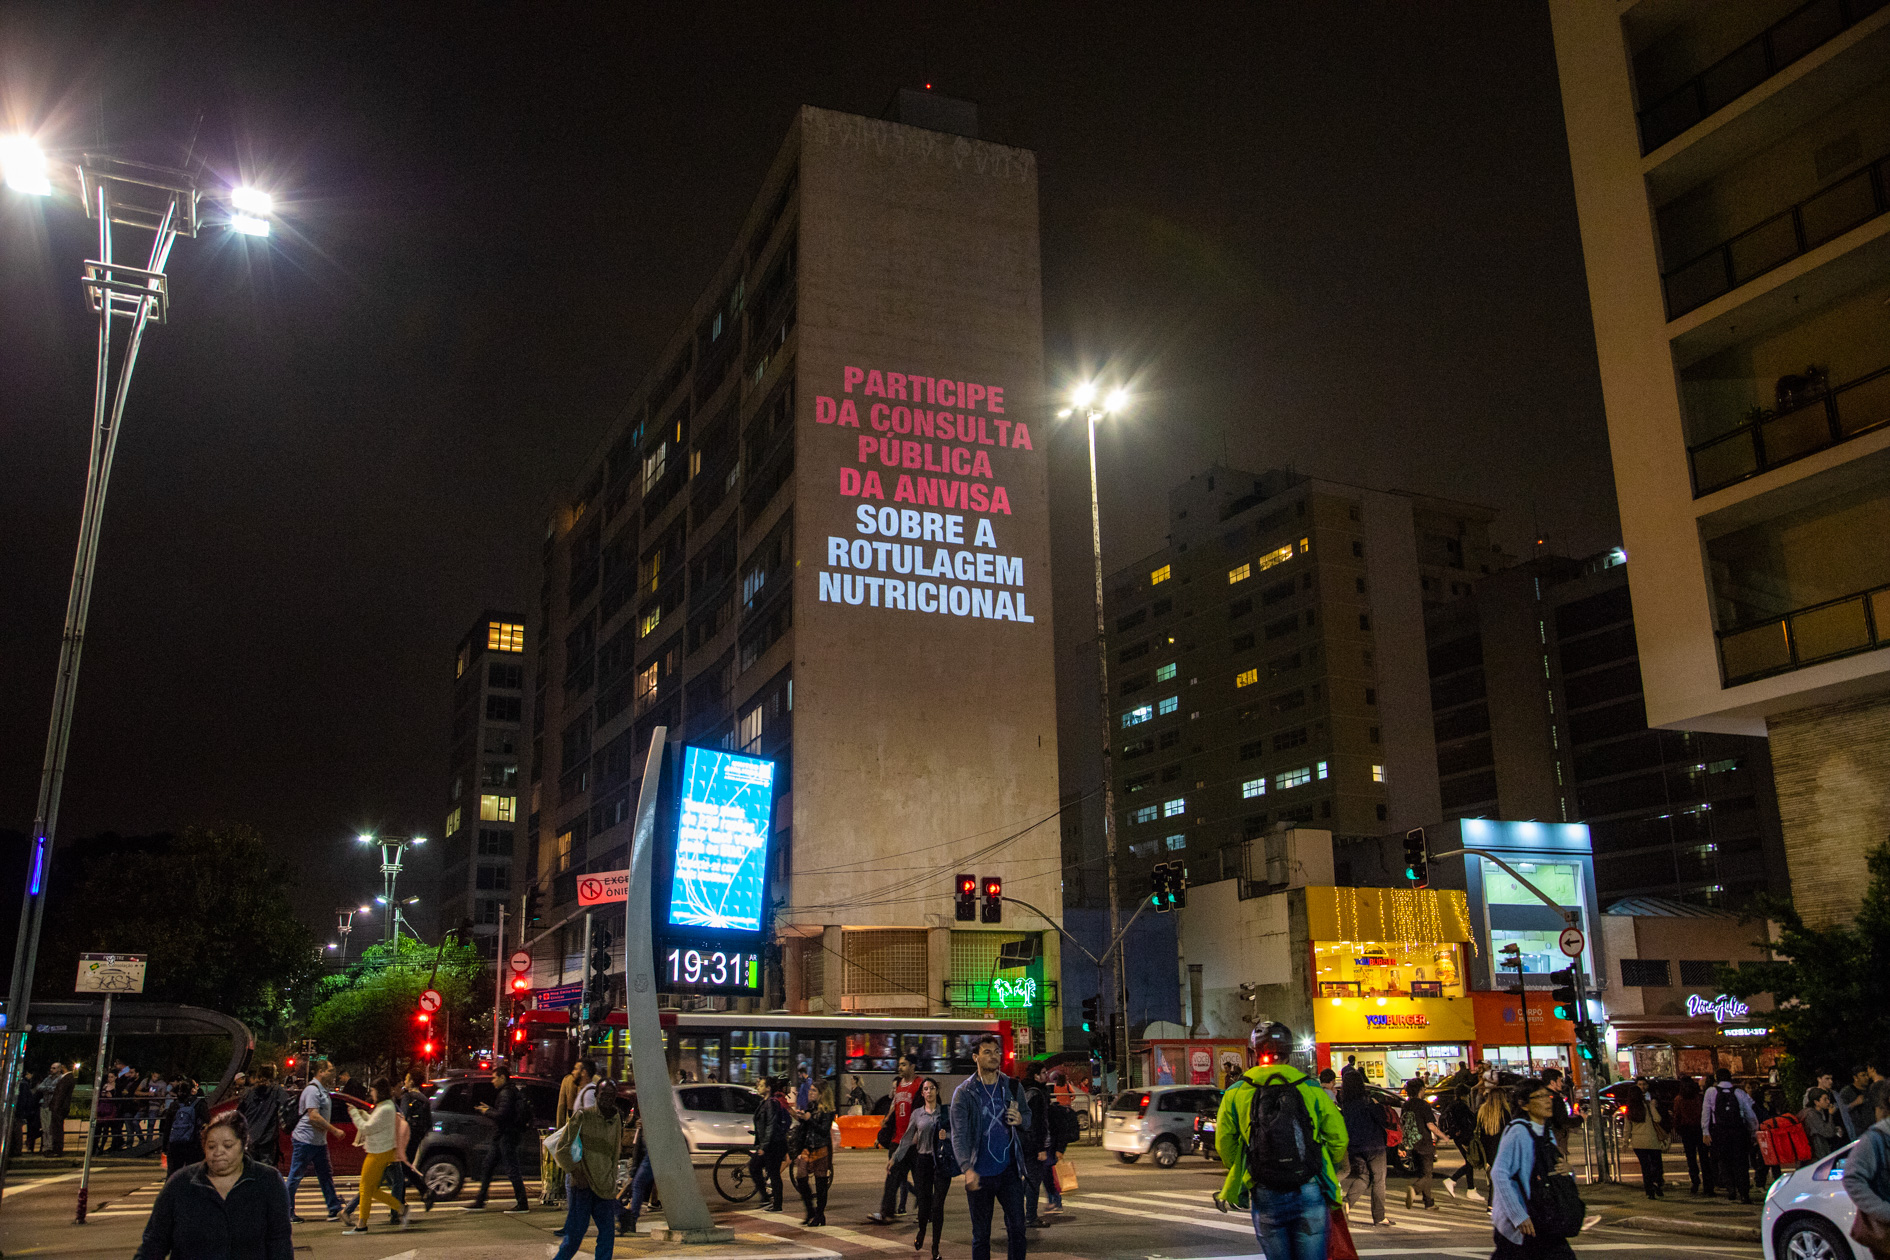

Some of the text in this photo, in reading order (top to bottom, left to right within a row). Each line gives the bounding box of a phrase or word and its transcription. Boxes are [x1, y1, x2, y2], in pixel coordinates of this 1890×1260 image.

[844, 366, 1005, 414] PARTICIPE
[815, 396, 1033, 450] DA CONSULTA
[858, 431, 993, 478] PÚBLICA
[839, 467, 1012, 515] DA ANVISA
[856, 504, 997, 548] SOBRE A
[828, 536, 1024, 587] ROTULAGEM
[819, 571, 1035, 623] NUTRICIONAL
[668, 948, 741, 985] 19:31
[899, 1102, 906, 1117] 1
